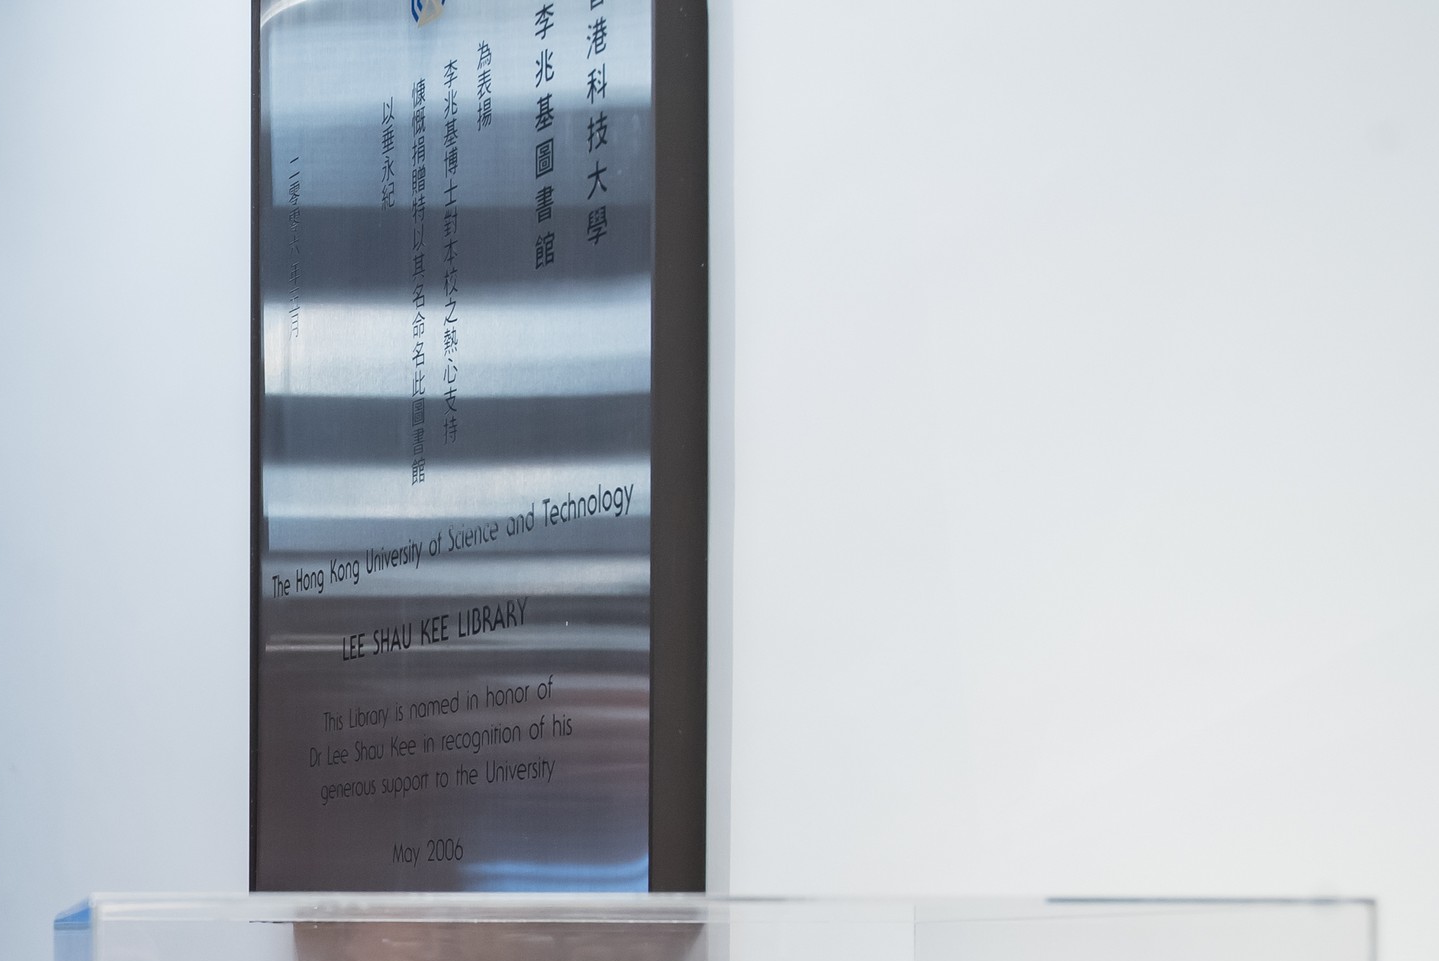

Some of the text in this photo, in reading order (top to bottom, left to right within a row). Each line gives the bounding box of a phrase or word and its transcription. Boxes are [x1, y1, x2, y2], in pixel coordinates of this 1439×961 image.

[476, 41, 492, 131] 為表揚
[381, 96, 395, 211] 以垂永紀
[535, 4, 555, 270] 李兆基圖書館
[443, 59, 458, 445] 李兆基博士對本校之熱心支持
[271, 483, 635, 598] The Hong Kong University of Science and Technology
[342, 596, 530, 661] LEE SHAU KEE LIBRARY
[309, 714, 573, 767] Dr Lee Shau Kee in recognition of his
[323, 674, 555, 732] This Library is named in honor of
[320, 756, 556, 805] generous support to the University
[392, 838, 464, 869] May 2006
